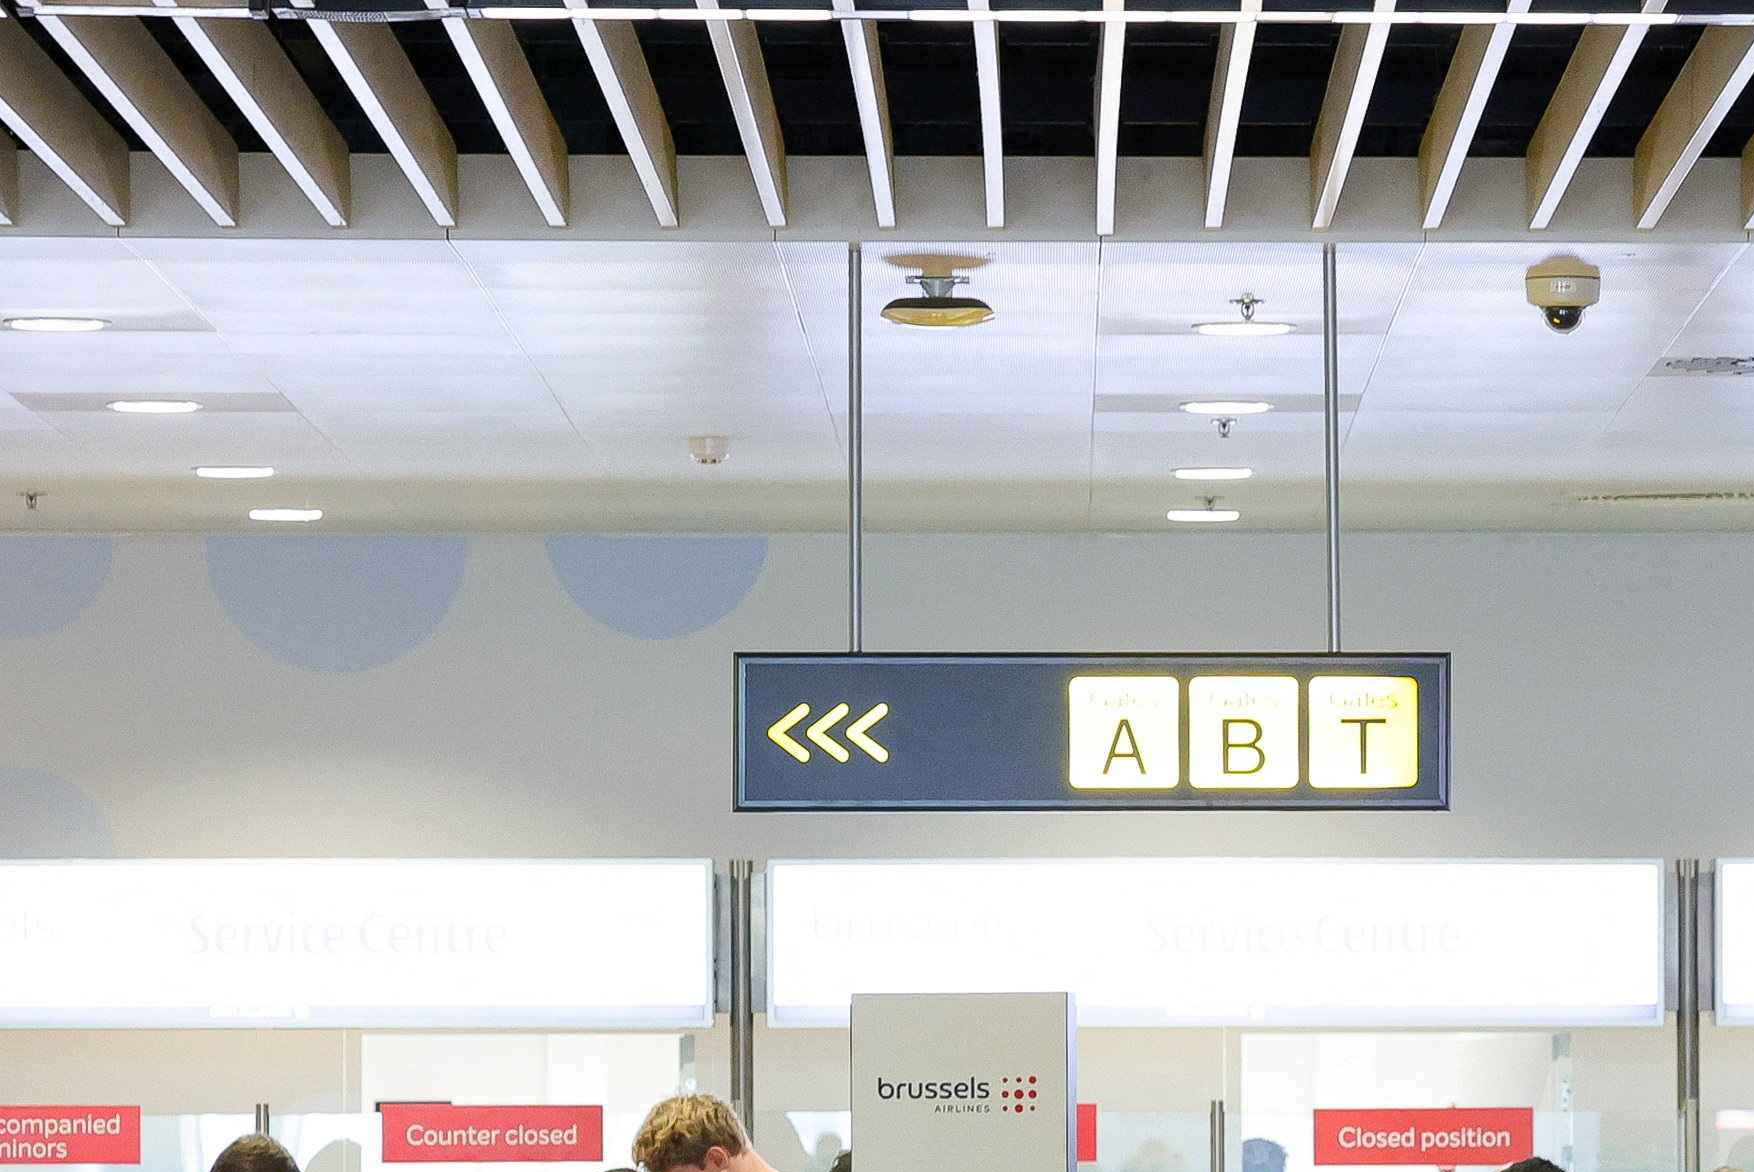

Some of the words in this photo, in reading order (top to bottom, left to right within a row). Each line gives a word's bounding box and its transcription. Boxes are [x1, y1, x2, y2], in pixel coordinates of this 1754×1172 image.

[1329, 691, 1400, 709] Gates
[1102, 718, 1147, 775] A
[1222, 718, 1266, 775] B
[1340, 718, 1387, 775] T
[357, 913, 508, 955] Centre
[877, 1076, 990, 1100] brussels
[934, 1104, 990, 1115] AIRLINES
[405, 1123, 501, 1147] Counter
[504, 1123, 578, 1147] closed
[1338, 1126, 1415, 1149] Closed
[1420, 1127, 1512, 1152] position
